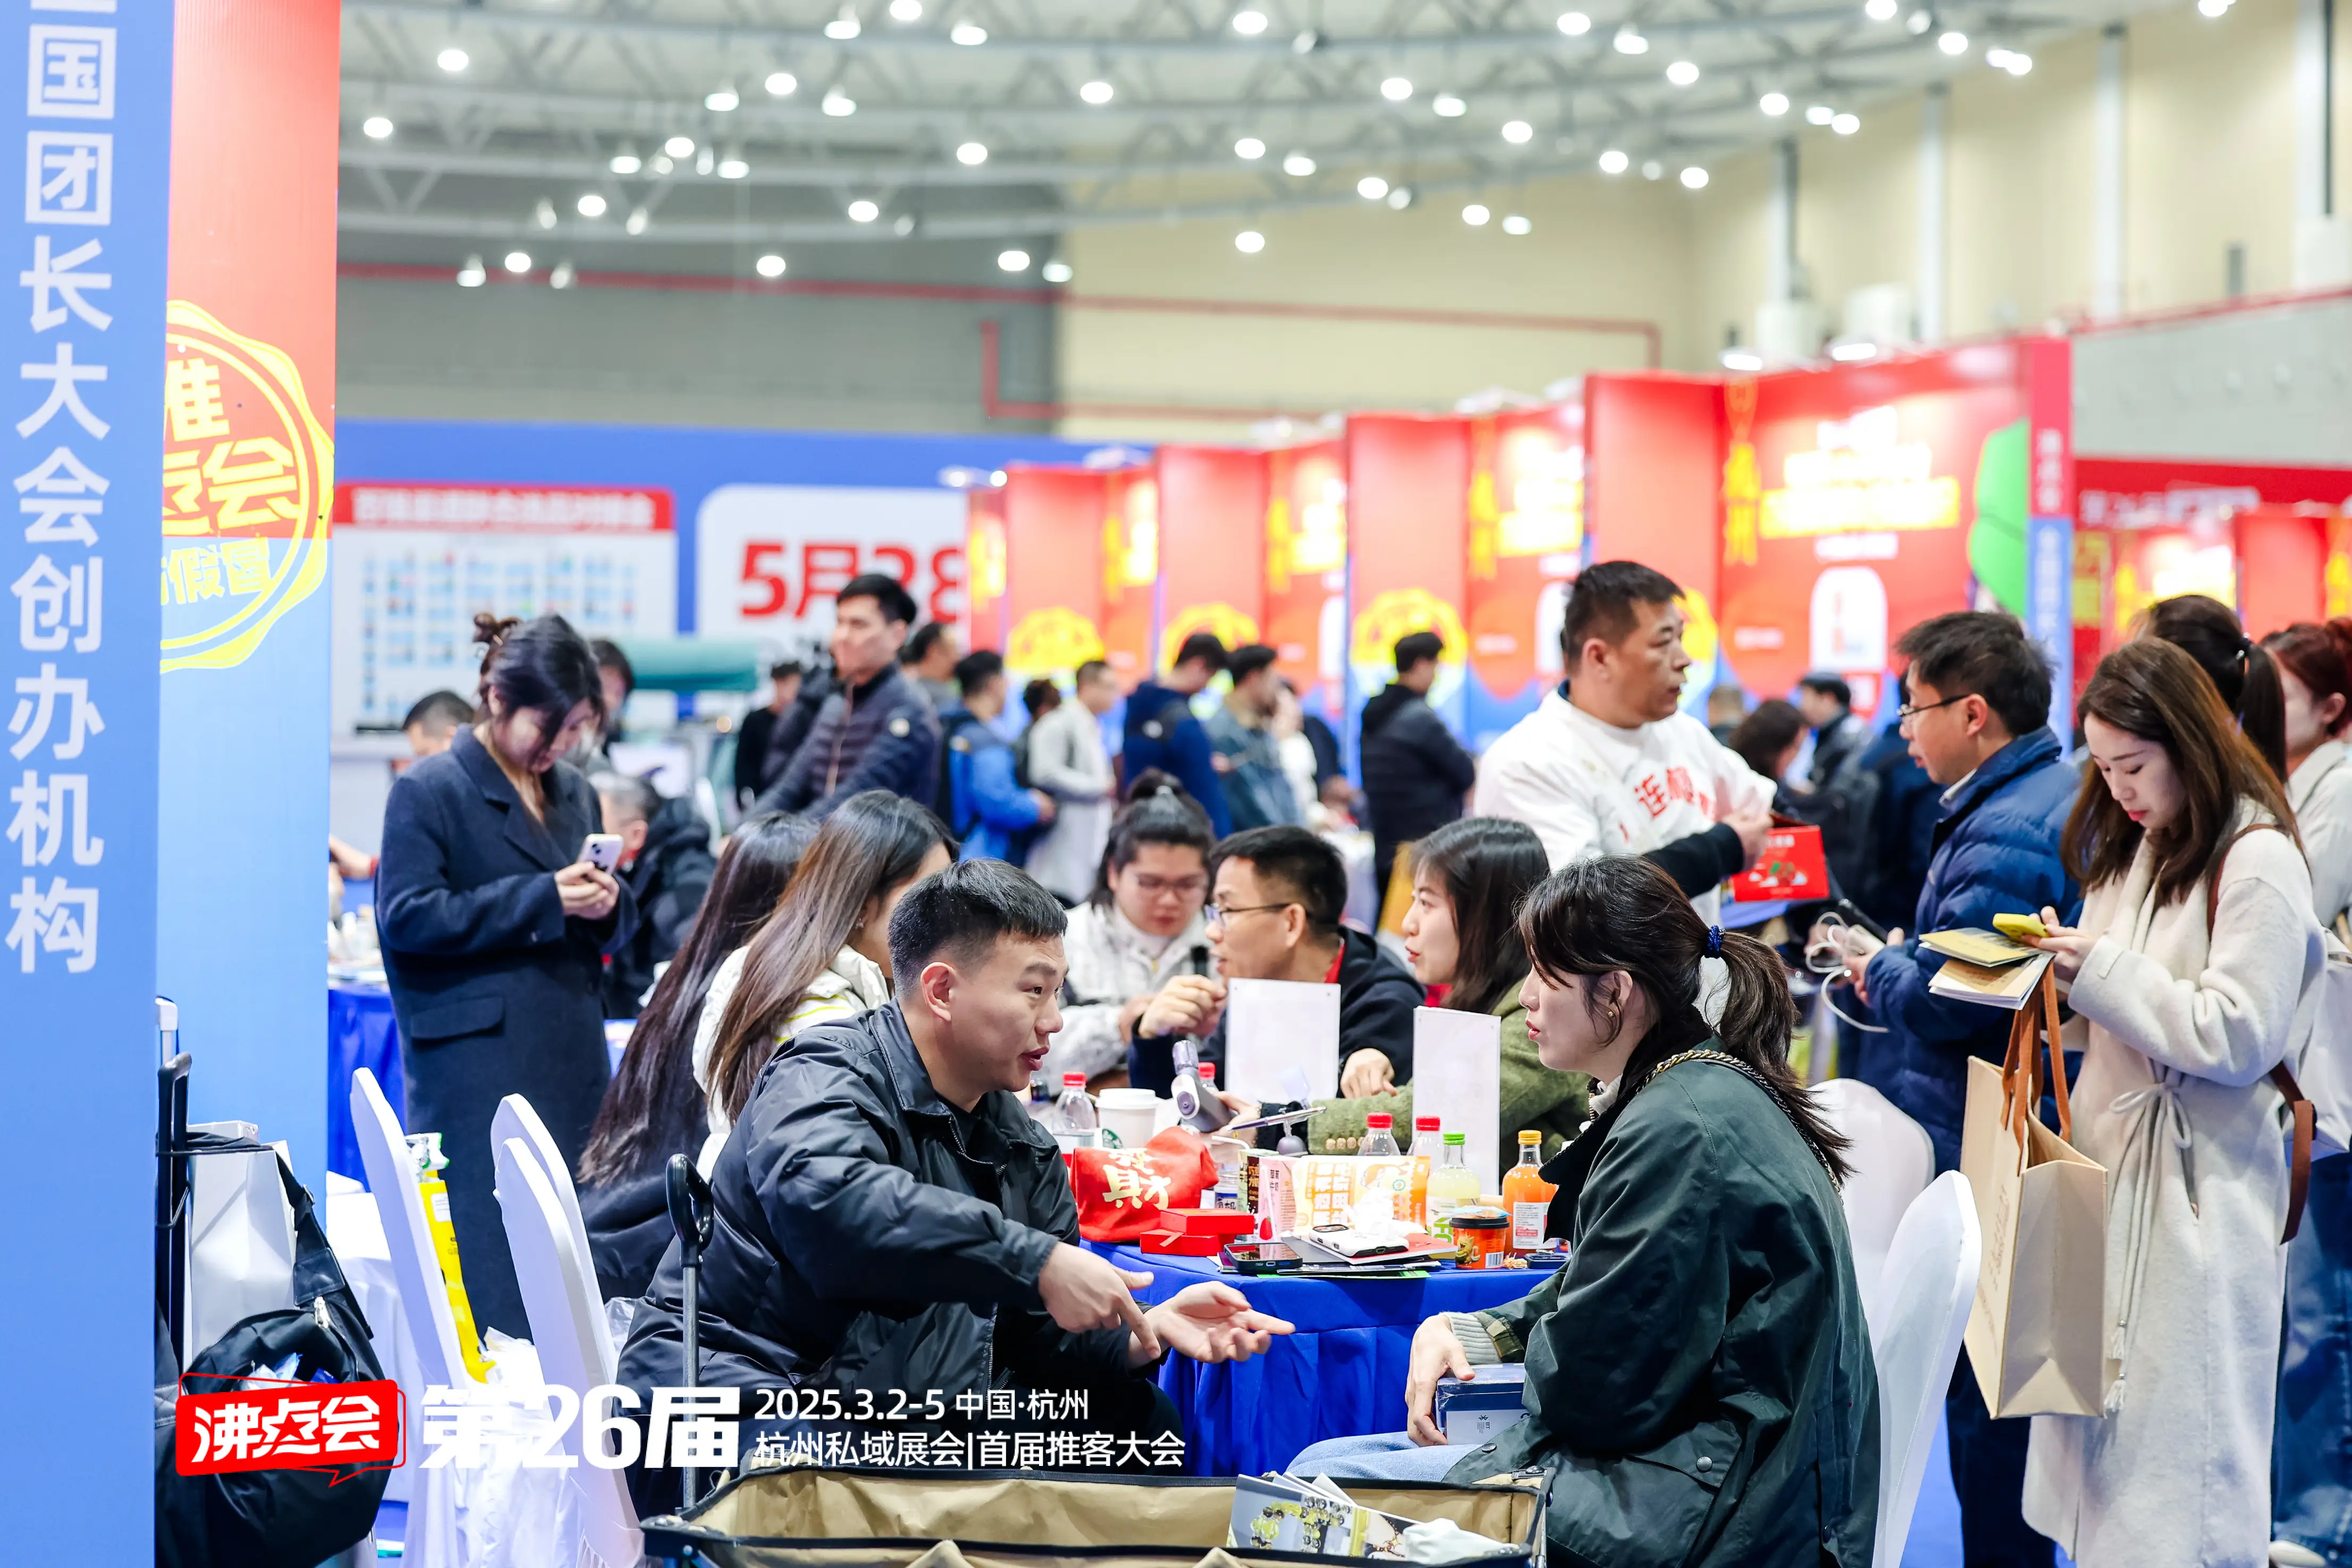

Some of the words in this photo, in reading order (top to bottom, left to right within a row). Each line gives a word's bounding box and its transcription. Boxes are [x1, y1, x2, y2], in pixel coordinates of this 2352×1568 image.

[6, 0, 116, 973] 国团长大会创办机构
